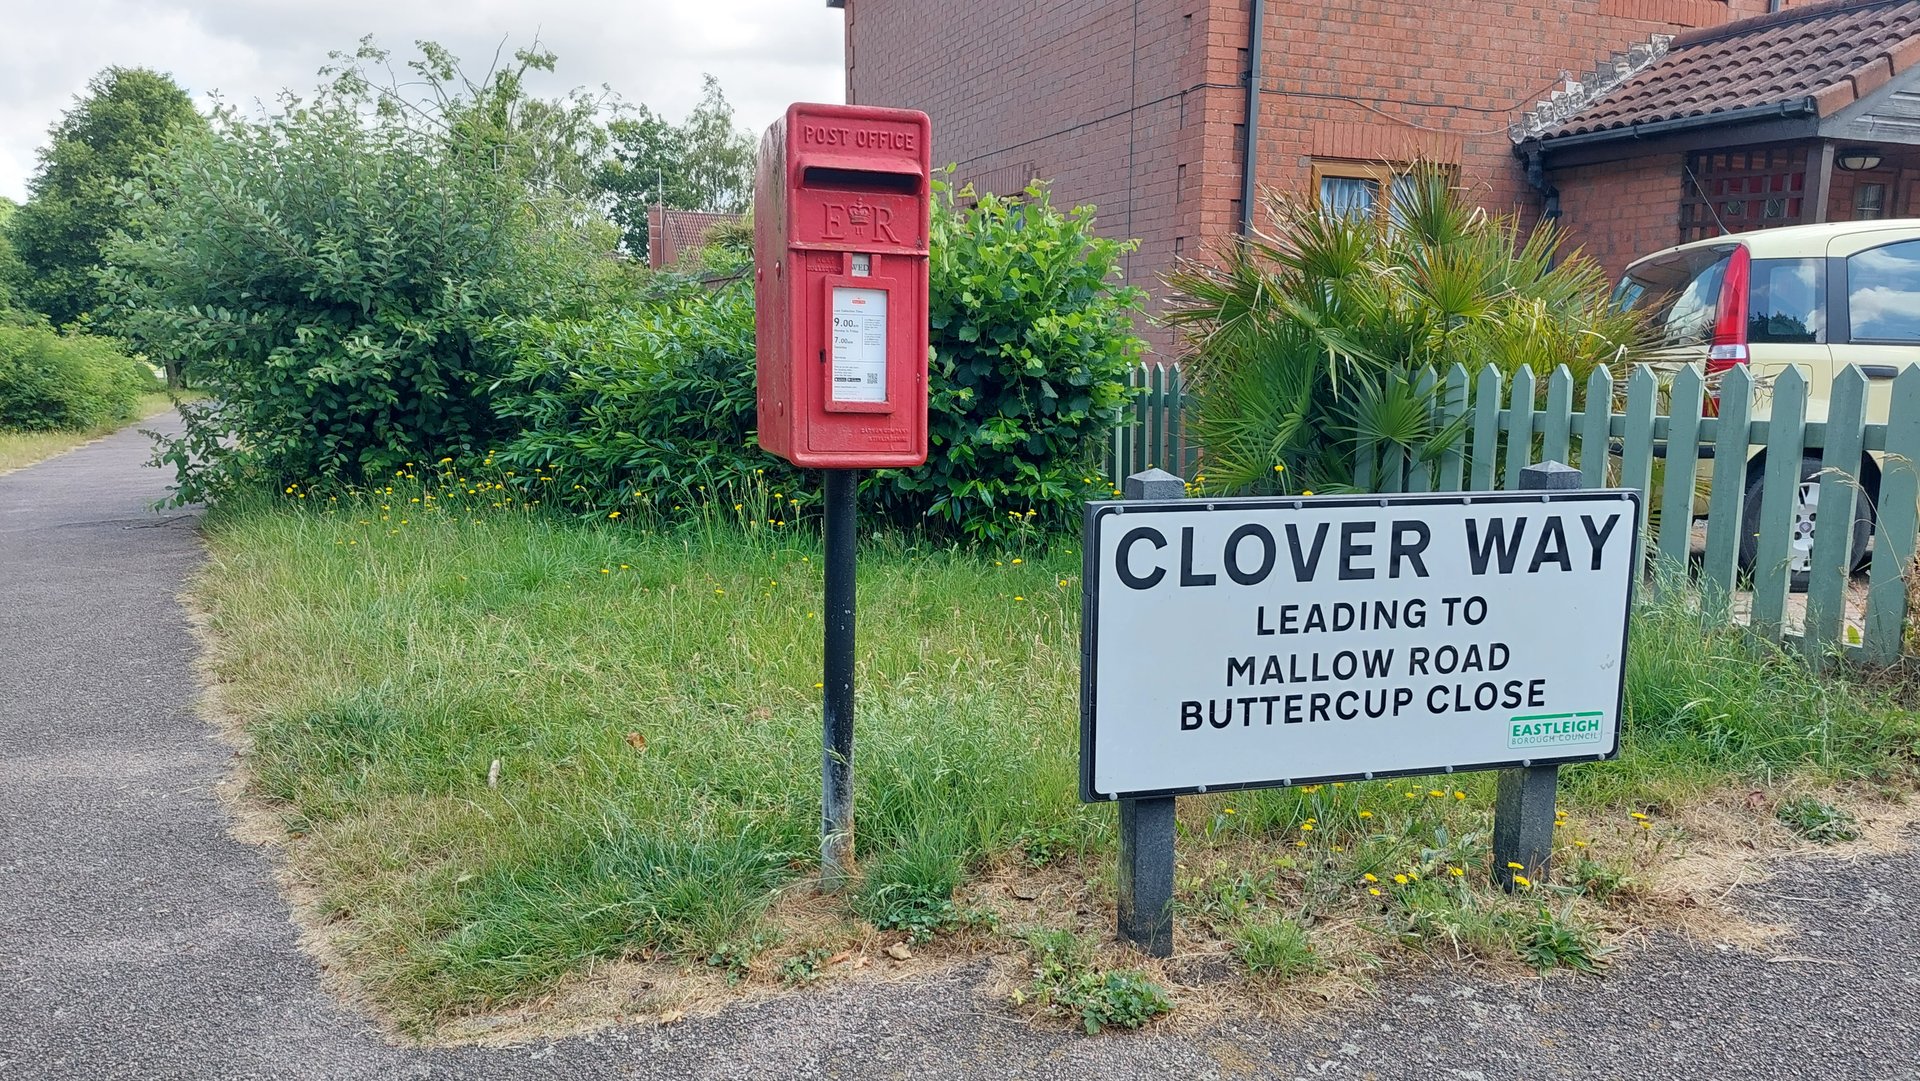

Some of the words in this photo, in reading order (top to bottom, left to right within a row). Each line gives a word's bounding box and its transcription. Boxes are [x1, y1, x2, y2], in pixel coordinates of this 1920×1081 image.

[804, 124, 849, 146] POST
[856, 128, 915, 151] OFFICE
[852, 263, 870, 272] WED
[1115, 519, 1431, 591] CLOVER
[1464, 513, 1622, 576] WAY
[1257, 598, 1427, 636] LEADING
[1441, 595, 1488, 627] TO
[1226, 648, 1395, 687] MALLOW
[1408, 642, 1511, 676] ROAD
[1180, 687, 1414, 731] BUTTERCUP
[1426, 678, 1547, 715] CLOSE
[1511, 735, 1556, 745] BOROUGH
[1558, 732, 1599, 743] COUNCIL
[1512, 719, 1600, 737] EASTLEIGH
